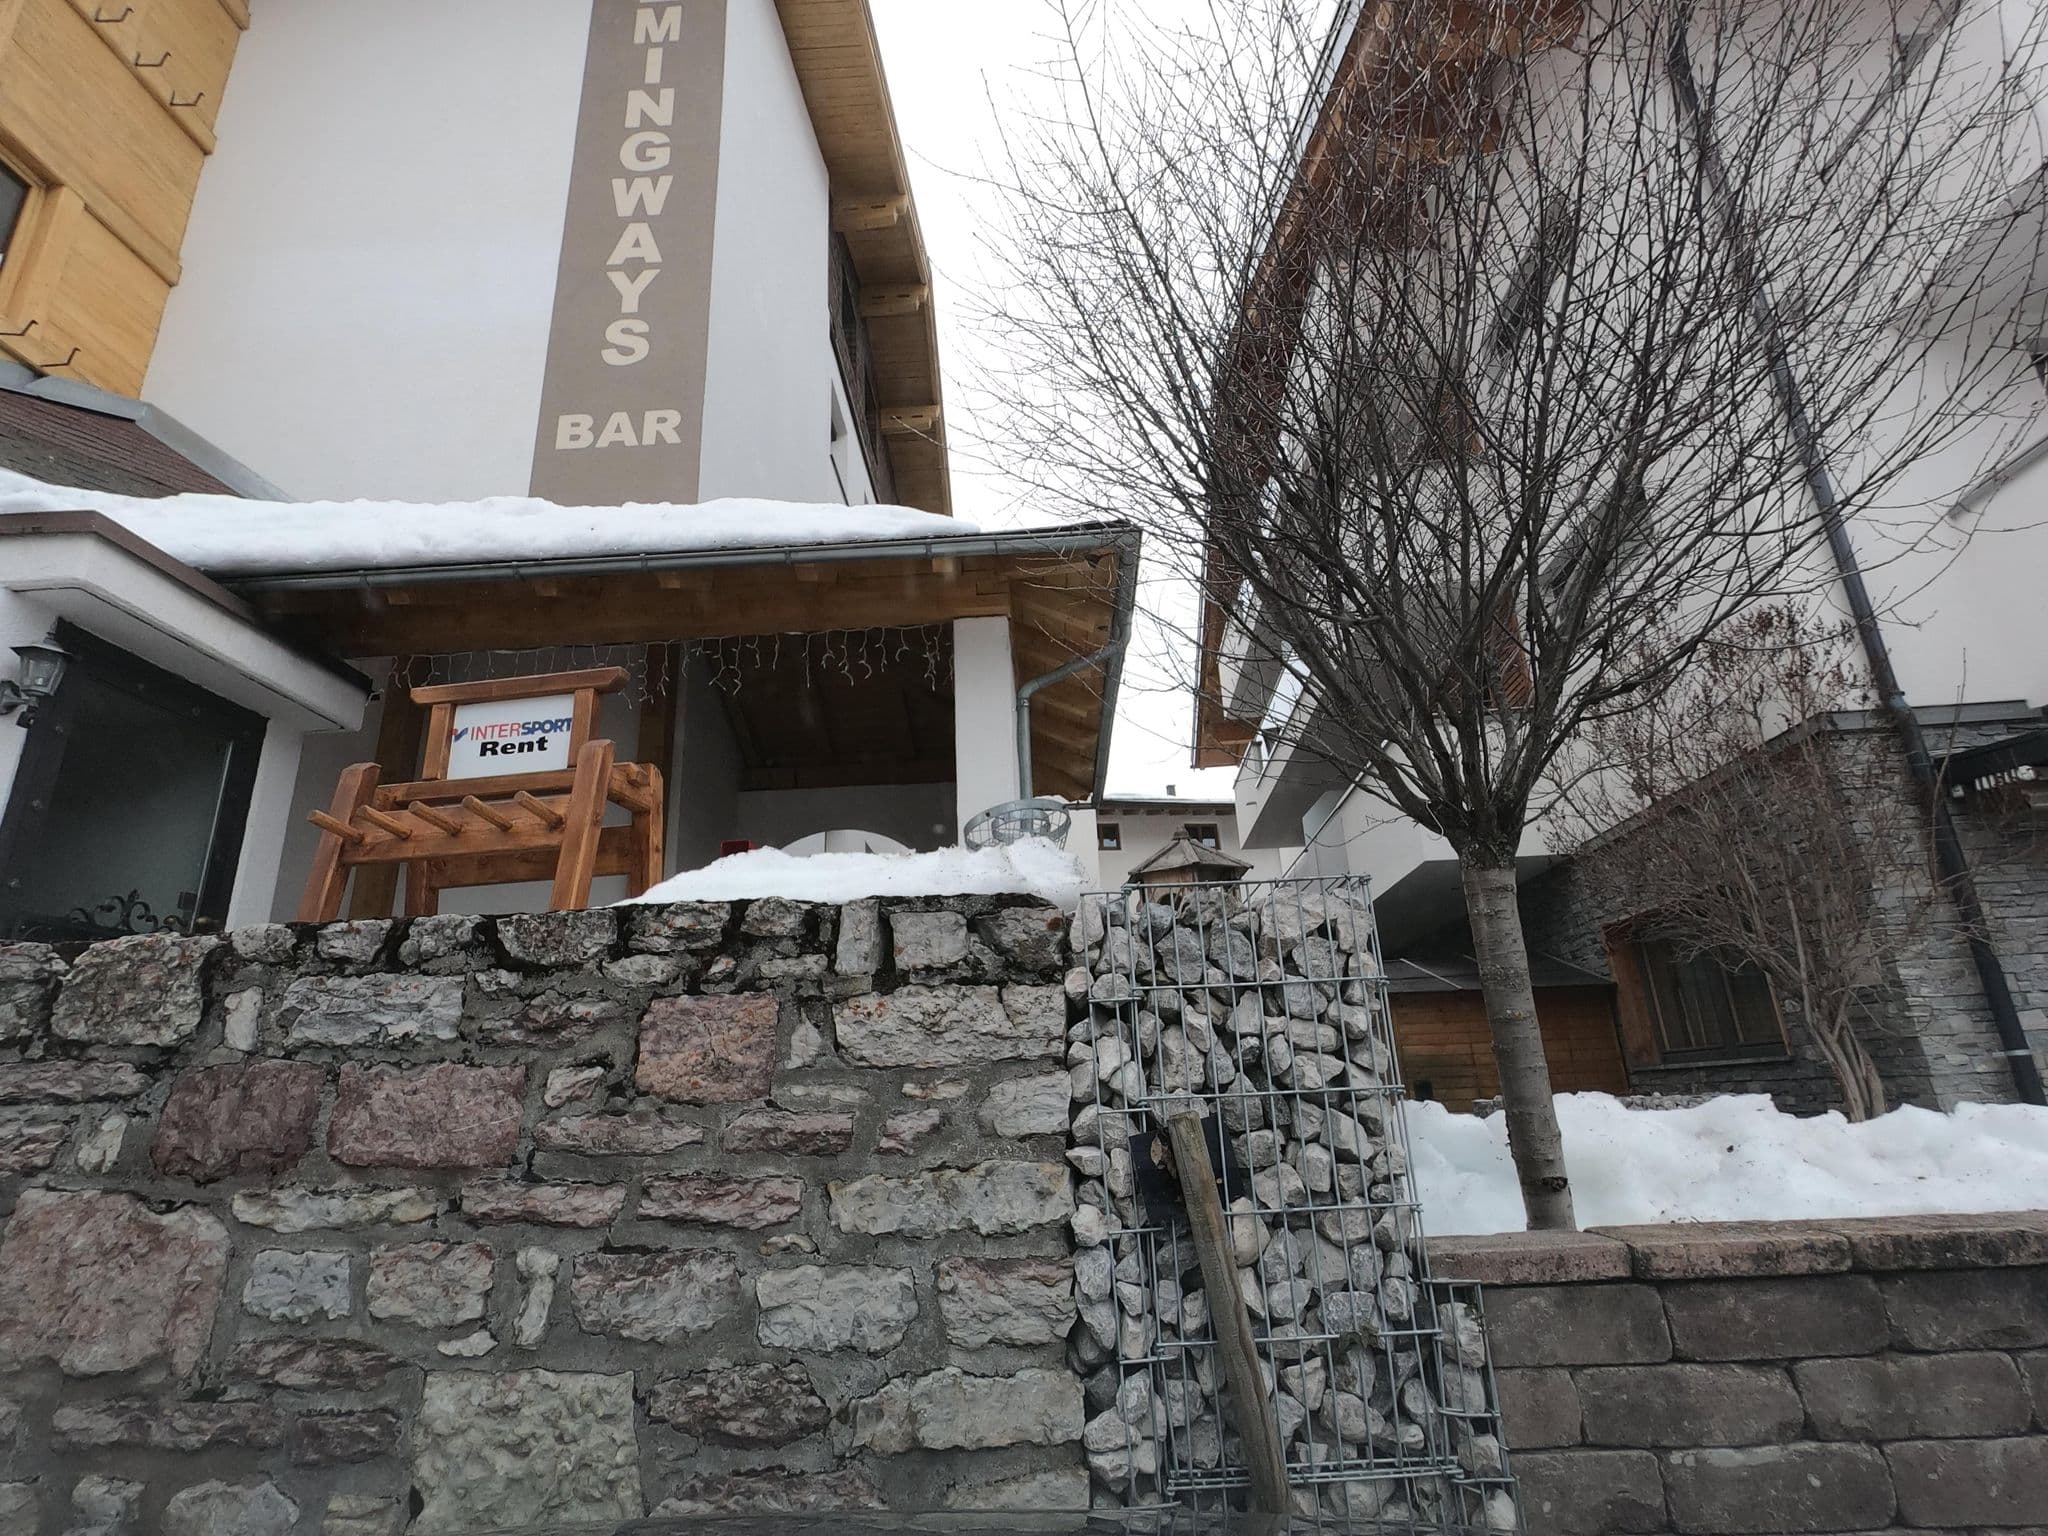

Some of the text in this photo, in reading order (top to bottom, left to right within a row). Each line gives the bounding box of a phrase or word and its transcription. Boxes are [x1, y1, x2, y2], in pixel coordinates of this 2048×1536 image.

[600, 0, 682, 367] MINGWAYS
[555, 409, 682, 450] BAR
[470, 717, 573, 741] INTERSPORT
[479, 735, 549, 757] Rent
